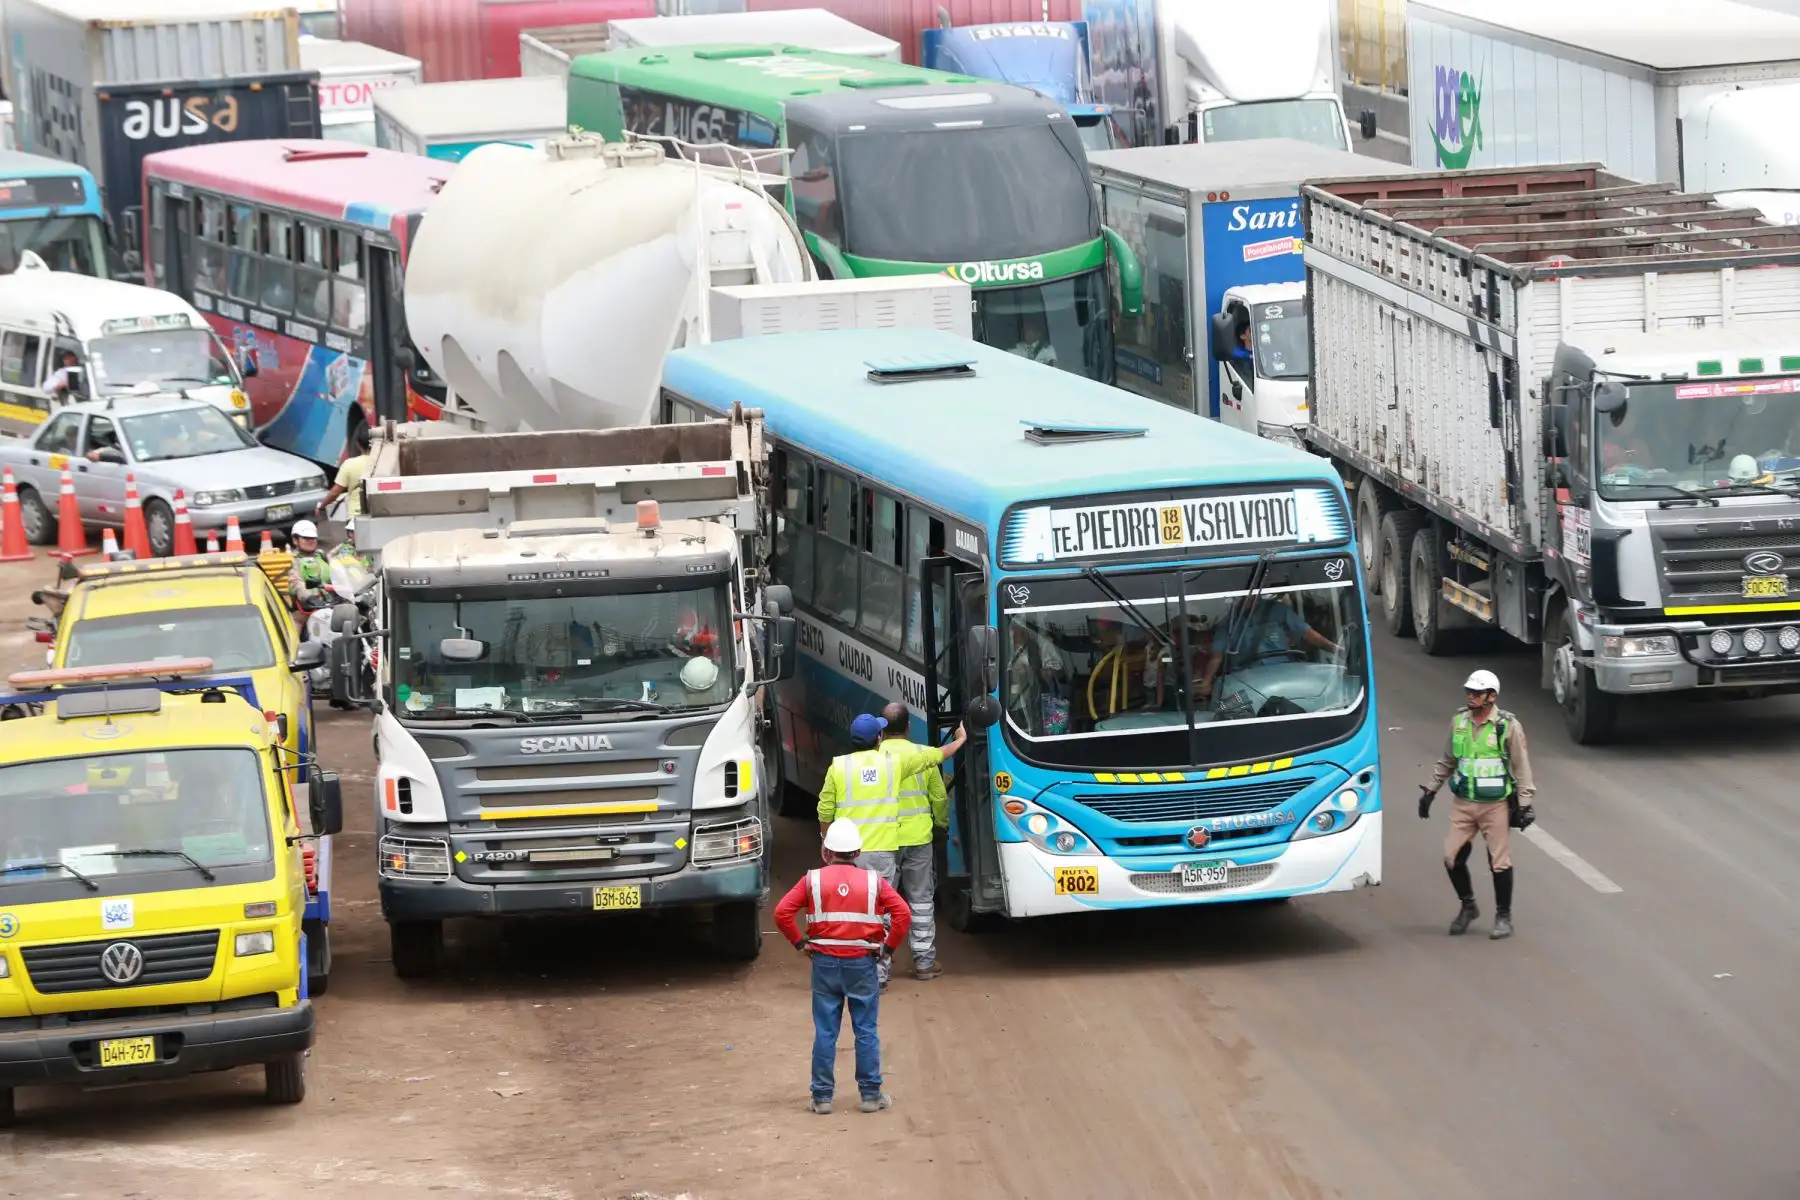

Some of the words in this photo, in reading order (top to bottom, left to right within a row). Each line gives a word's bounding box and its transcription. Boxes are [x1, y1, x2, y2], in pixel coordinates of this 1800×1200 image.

[122, 95, 238, 140] ausa
[1227, 203, 1301, 231] Sani
[960, 260, 1044, 283] Oltursa
[1163, 509, 1179, 524] 18
[1163, 525, 1181, 541] 02
[838, 640, 873, 682] CIUDAD
[520, 735, 613, 754] SCANIA
[995, 775, 1009, 788] 05
[1057, 875, 1096, 892] 1802
[595, 891, 639, 907] D3M-863
[104, 1043, 152, 1063] D4H-757
